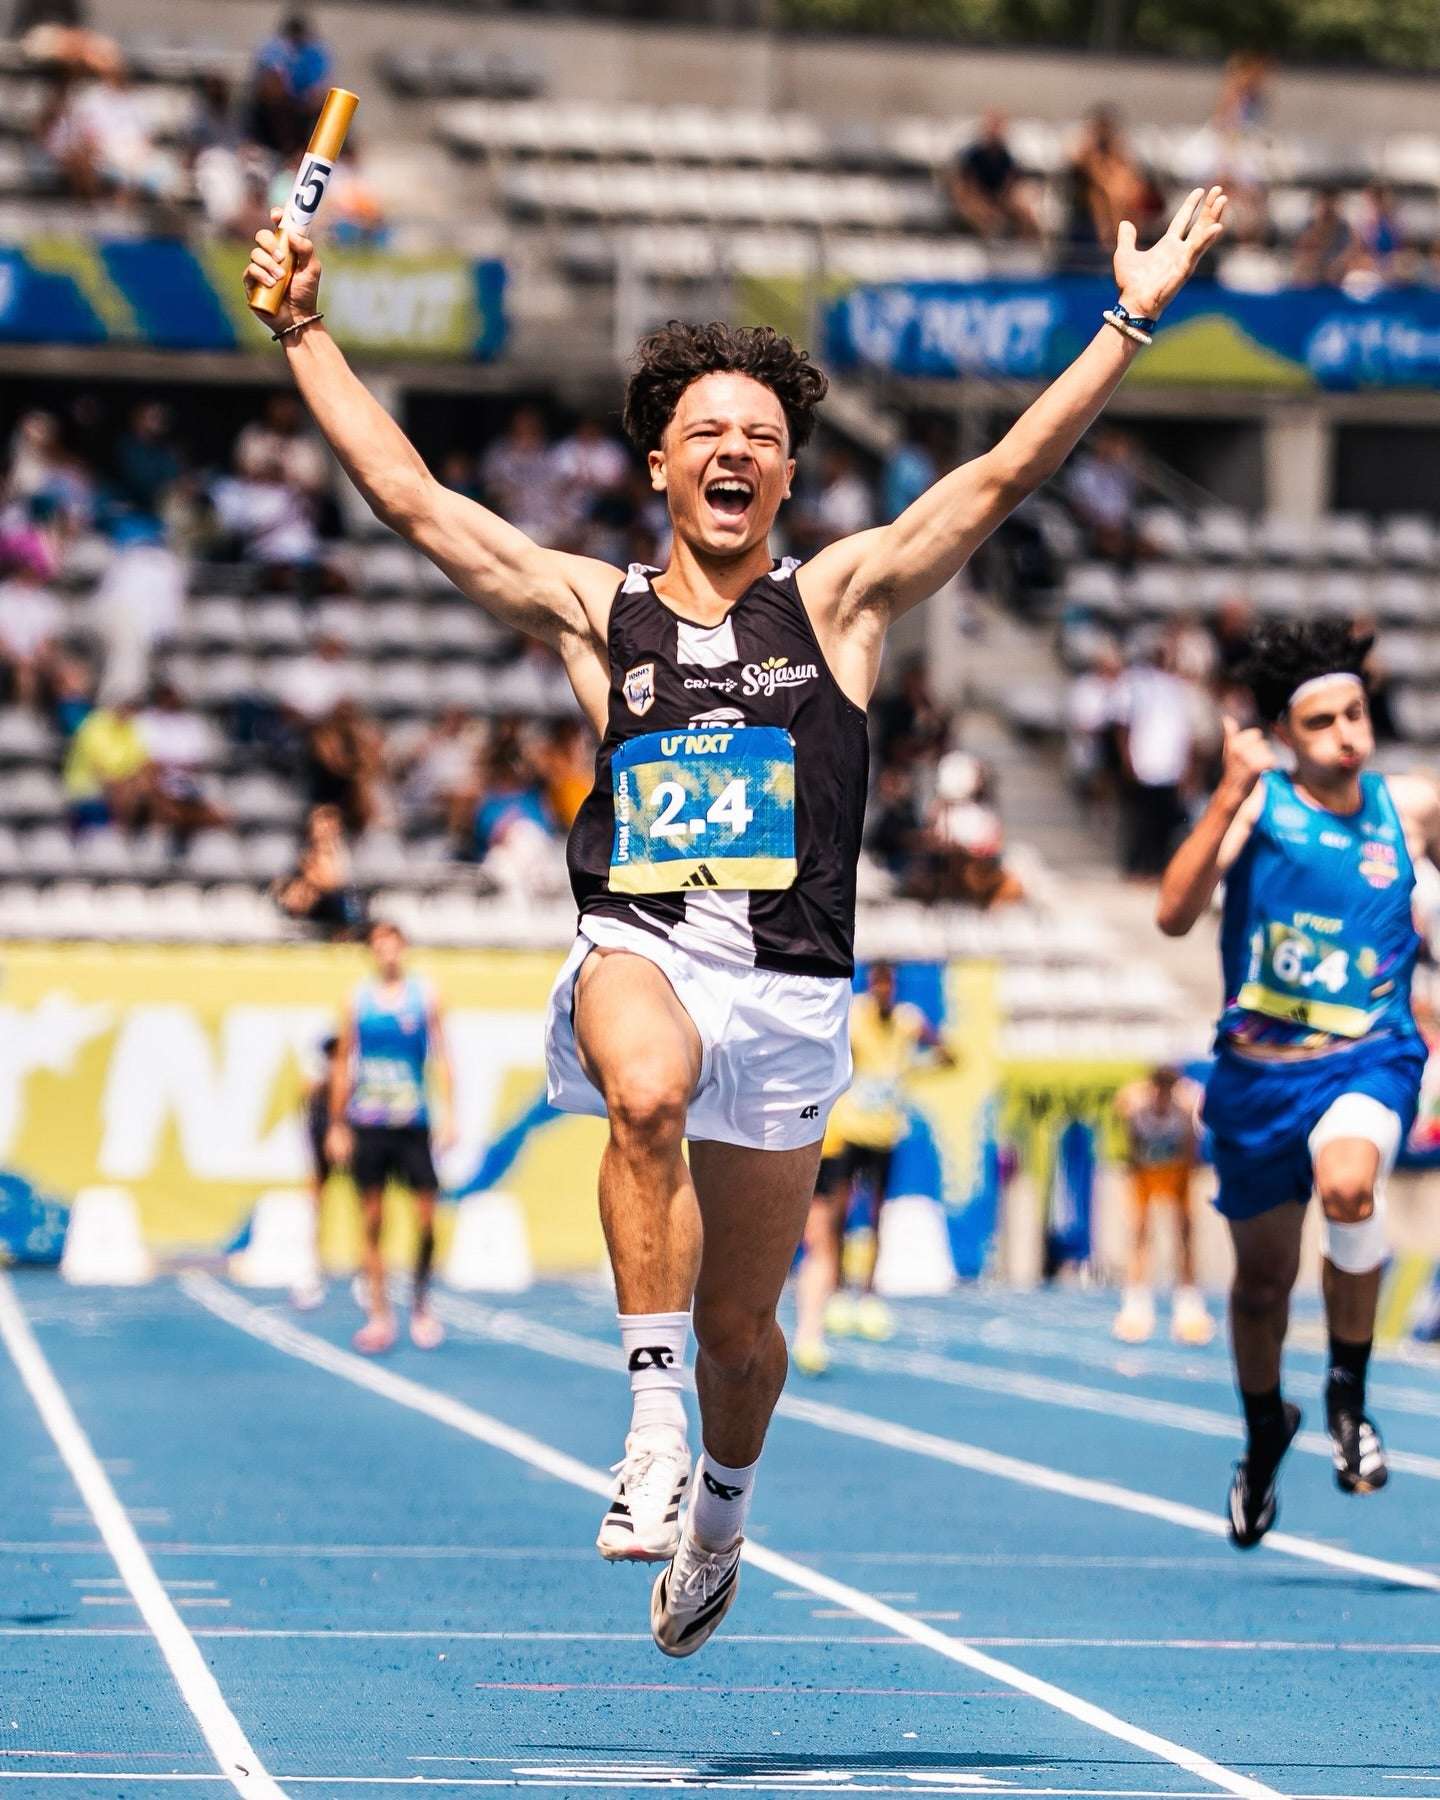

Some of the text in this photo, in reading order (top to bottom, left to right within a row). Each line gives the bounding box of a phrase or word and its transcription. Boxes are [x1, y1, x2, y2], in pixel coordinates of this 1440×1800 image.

[294, 161, 331, 214] 5
[741, 663, 819, 696] Sojasun
[649, 779, 754, 838] 2.4
[1272, 938, 1349, 994] 6.4
